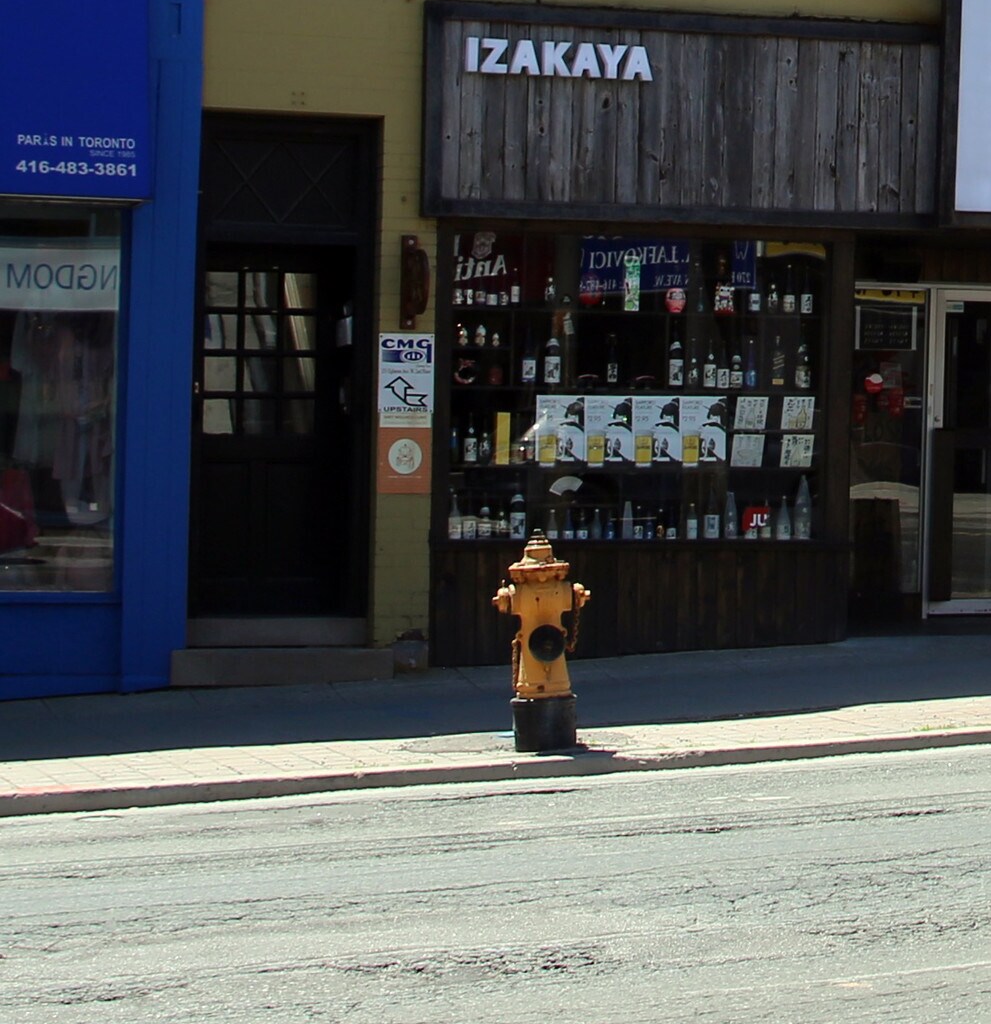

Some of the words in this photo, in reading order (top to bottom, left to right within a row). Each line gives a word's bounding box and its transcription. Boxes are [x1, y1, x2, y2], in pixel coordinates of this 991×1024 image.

[465, 37, 653, 81] IZAKAYA
[17, 133, 57, 146] PARIS
[61, 136, 73, 147] IN
[78, 137, 136, 149] TORONTO
[89, 149, 114, 158] SINCE
[16, 160, 136, 177] 416-483-3861
